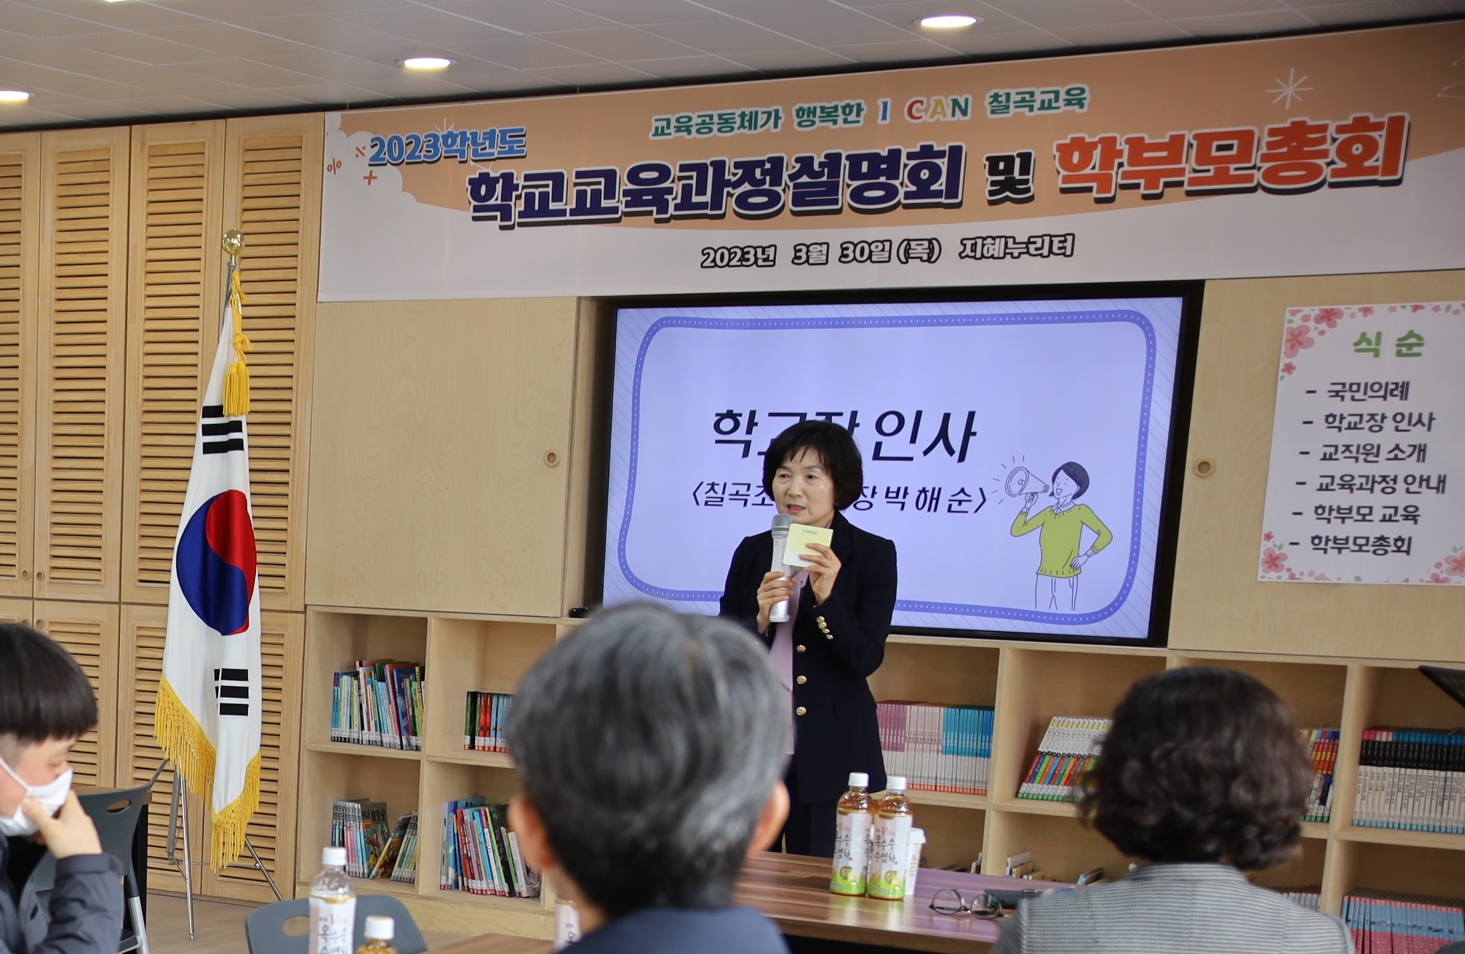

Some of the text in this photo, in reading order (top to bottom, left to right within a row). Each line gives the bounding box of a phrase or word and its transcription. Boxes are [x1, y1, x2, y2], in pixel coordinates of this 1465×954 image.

[651, 86, 1088, 138] 교육공동체가 행복한 I CAN 칠곡교육
[368, 126, 527, 167] 2023학년도
[468, 113, 1410, 229] 학교교육과정설명회 및 학부모총회
[701, 245, 777, 268] 2023년
[792, 243, 829, 266] 3월
[959, 233, 1075, 260] 지혜누리터
[1327, 381, 1411, 402] 국민의례
[1324, 412, 1388, 433] 학교장
[1392, 411, 1436, 432] 인사
[872, 409, 977, 463] 인사
[1320, 443, 1381, 463] 교직원
[1385, 443, 1427, 463] 소개
[1316, 474, 1398, 495] 교육과정
[1403, 474, 1447, 494] 안내
[1313, 504, 1374, 524] 학부모
[1379, 504, 1421, 525] 교육
[1310, 534, 1413, 556] 학부모총회
